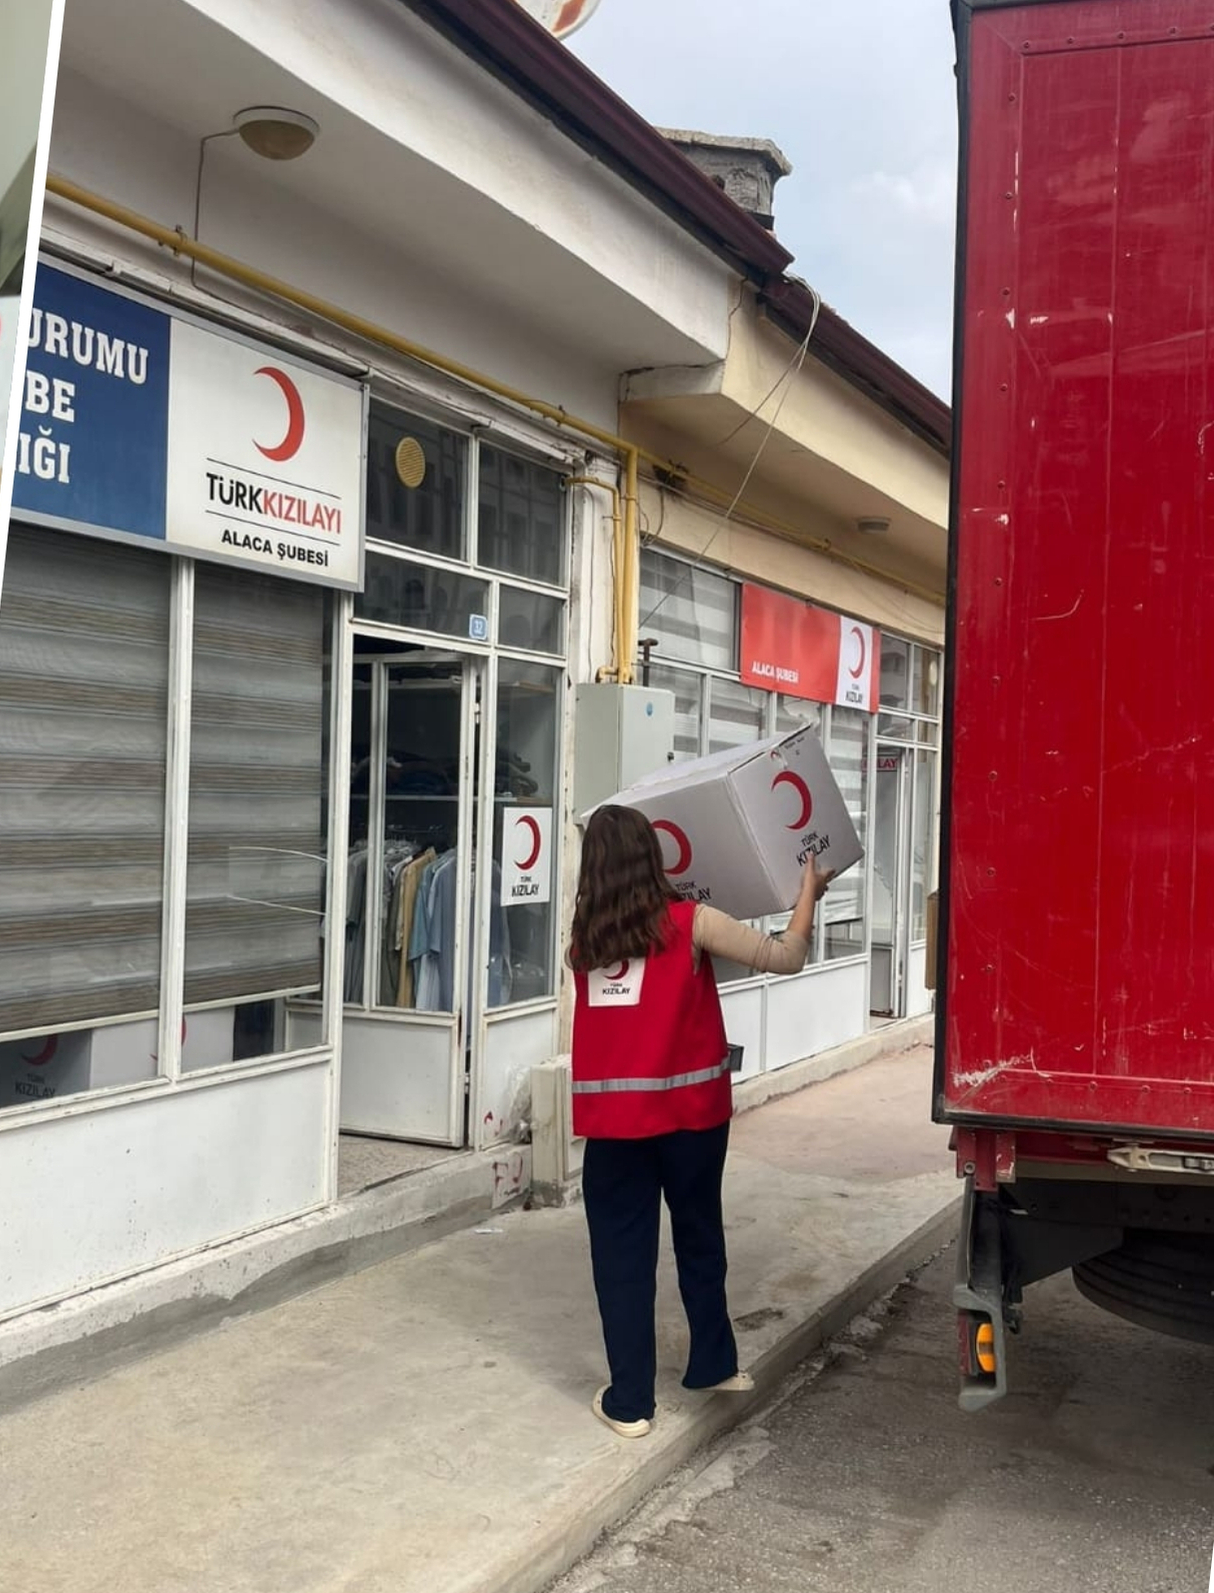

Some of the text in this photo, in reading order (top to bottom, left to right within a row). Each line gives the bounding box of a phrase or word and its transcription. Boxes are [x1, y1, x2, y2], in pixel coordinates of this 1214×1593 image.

[221, 528, 329, 568] ALACA ŞUBESİ
[751, 660, 775, 679] ALACA
[511, 883, 539, 897] KIZILAY
[602, 987, 630, 996] KIZILAY
